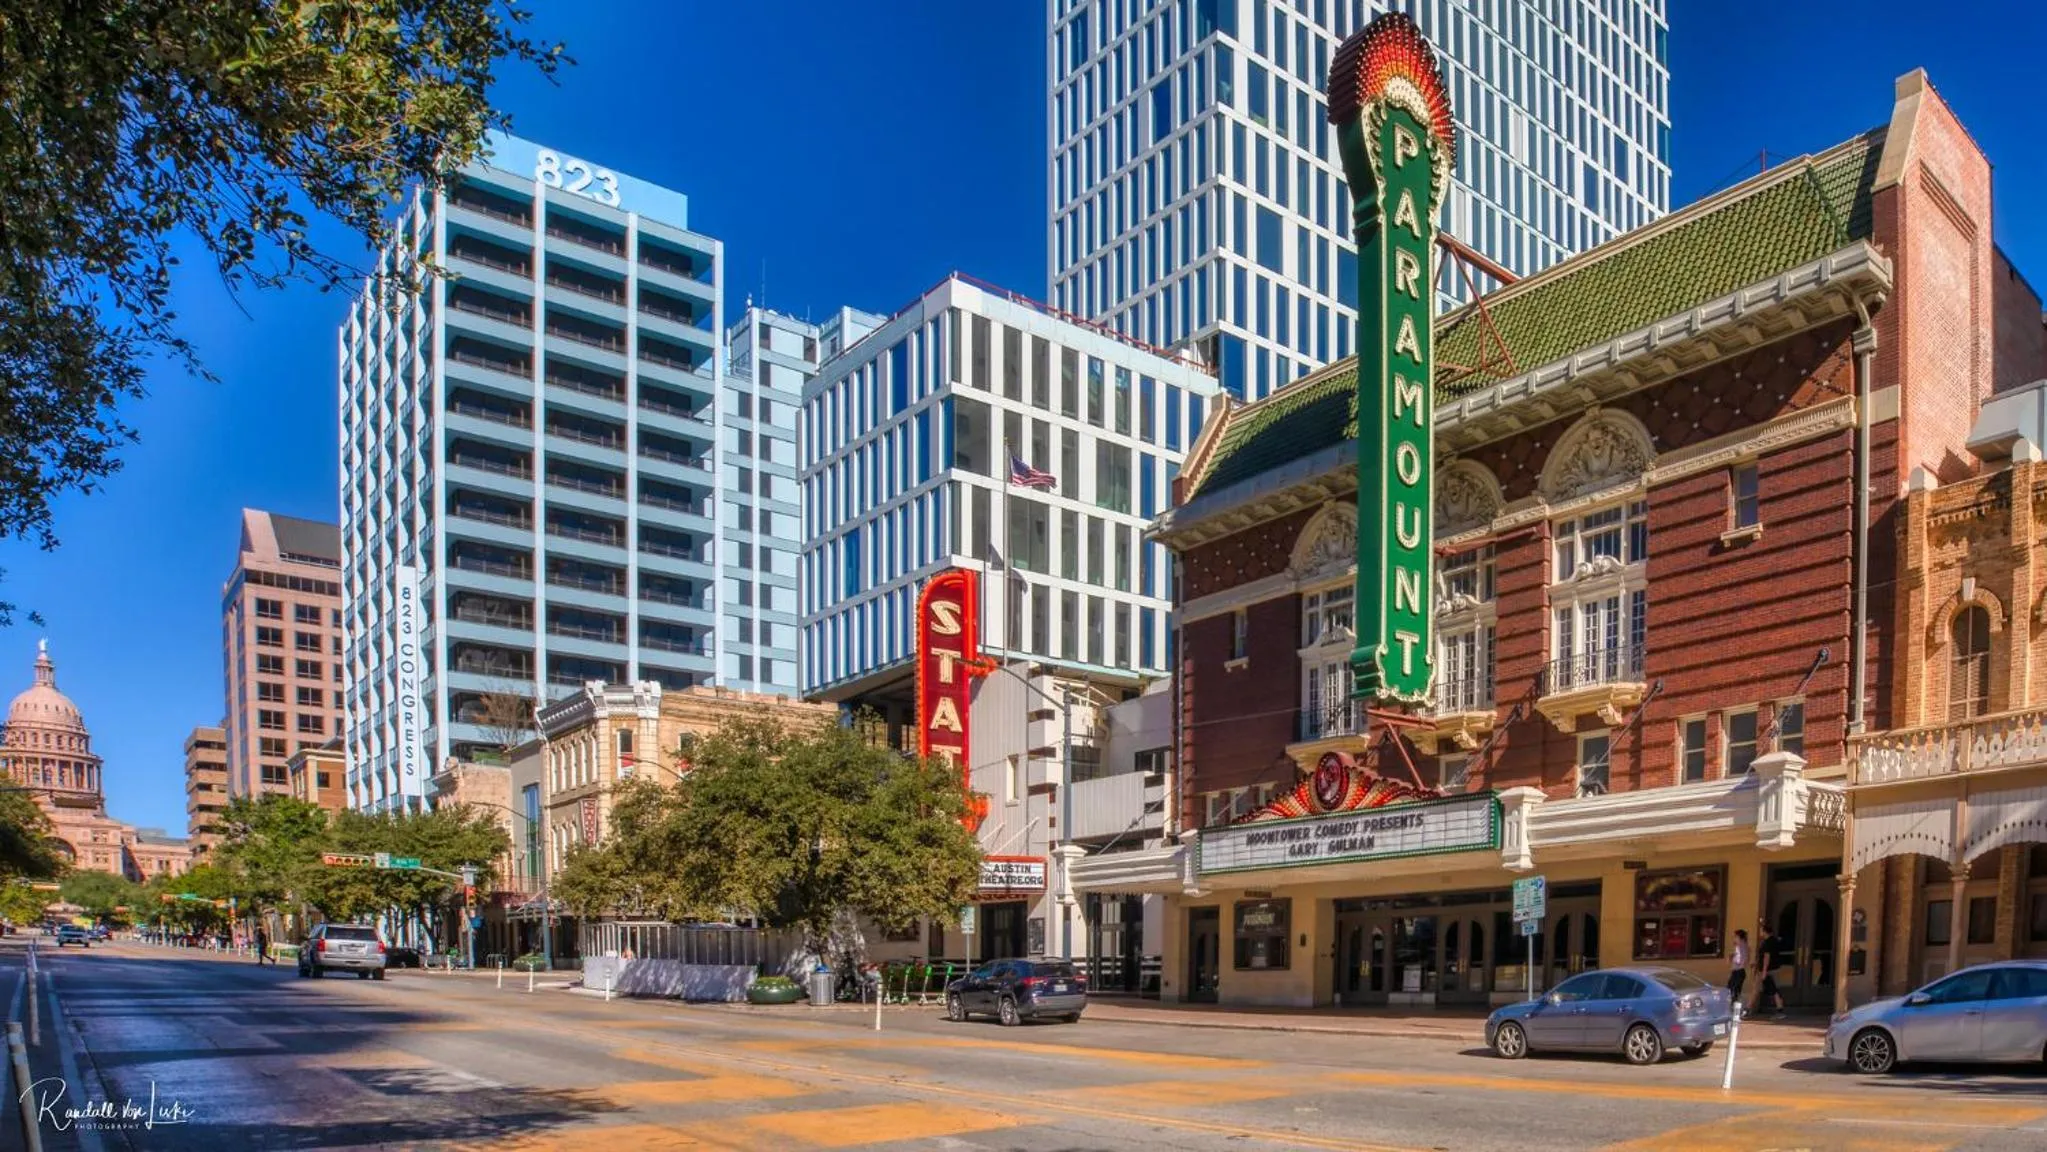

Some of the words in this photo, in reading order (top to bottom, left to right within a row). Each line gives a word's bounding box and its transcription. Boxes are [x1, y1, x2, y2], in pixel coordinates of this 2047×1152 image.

[536, 148, 622, 209] 823
[1394, 122, 1423, 678] PARAMOUNT
[401, 586, 412, 635] 823
[401, 643, 416, 777] CONGRESS
[929, 599, 964, 771] STAT
[1246, 826, 1311, 847] MOONTOWER
[1314, 820, 1359, 838] COMEDY
[1364, 813, 1425, 833] PRESENTS
[1289, 842, 1319, 857] GARY
[1328, 836, 1376, 852] GULMAN
[993, 864, 1032, 873] AUSTIN
